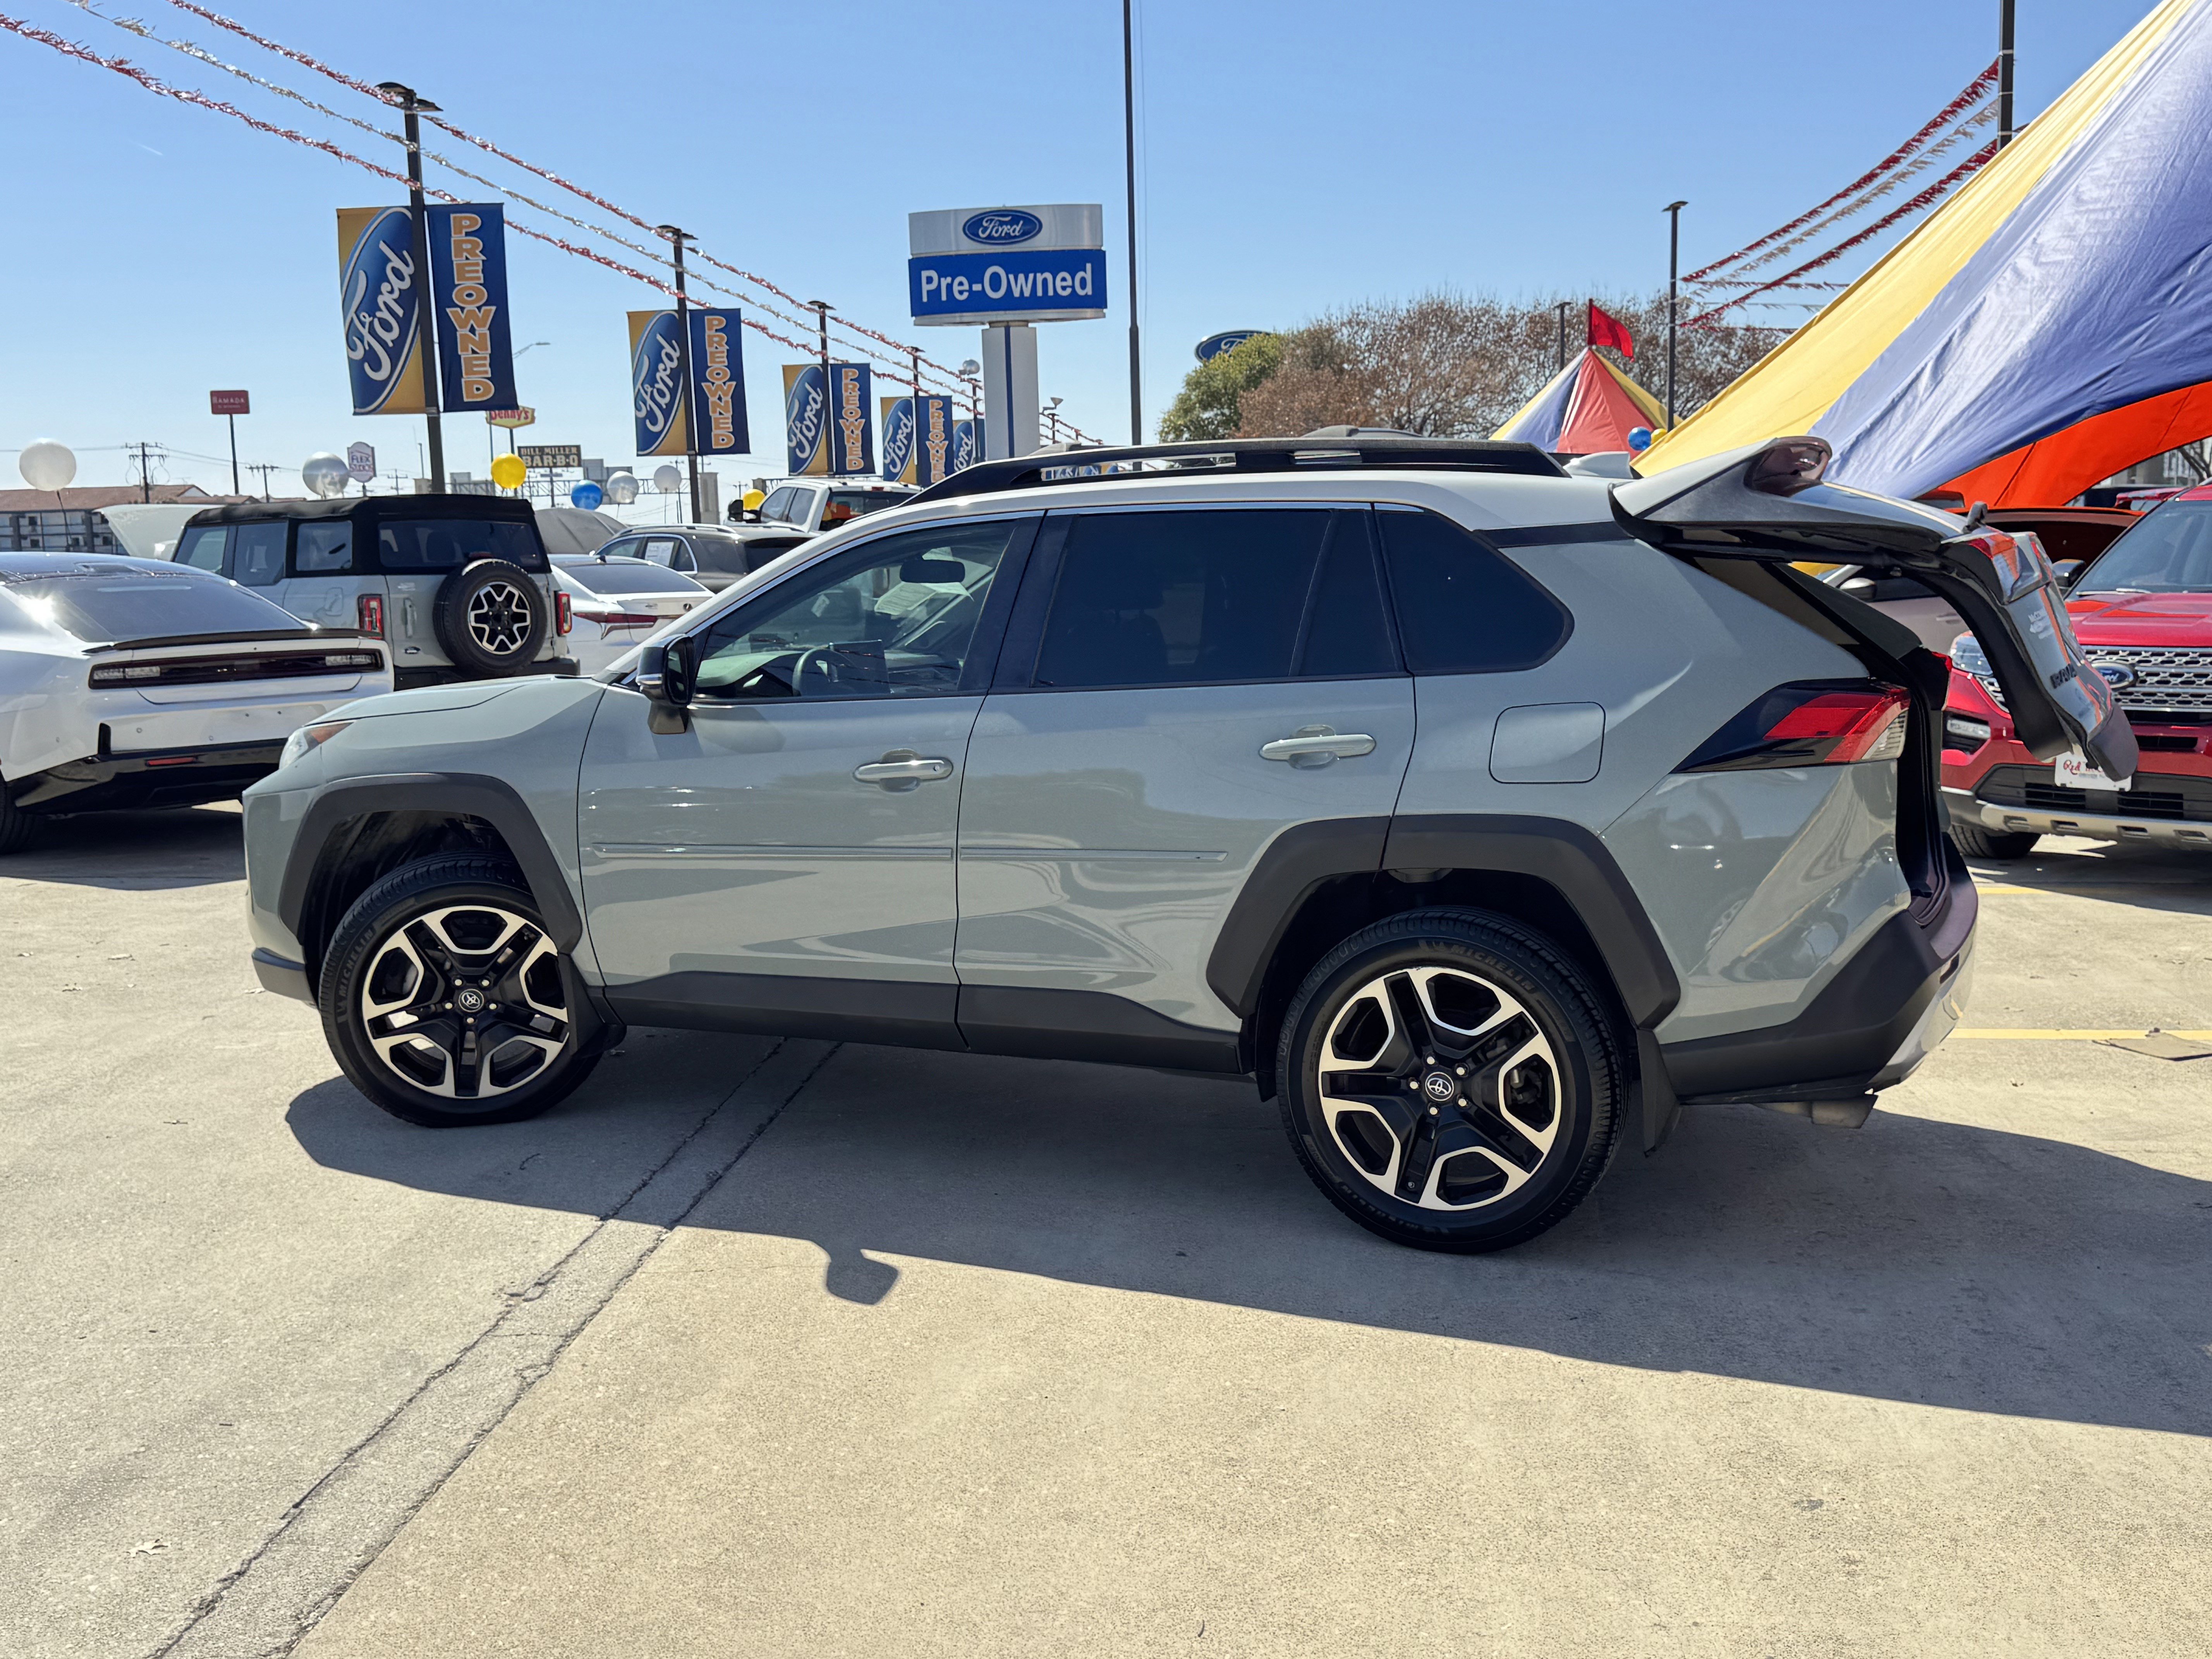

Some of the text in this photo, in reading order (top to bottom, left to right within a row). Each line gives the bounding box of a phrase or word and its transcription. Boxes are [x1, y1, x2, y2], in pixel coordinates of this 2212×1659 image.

[978, 215, 1024, 238] Ford
[346, 240, 415, 381] Ford
[446, 213, 497, 402] PREOWNED
[921, 263, 1092, 302] Pre-Owned
[634, 333, 680, 432] Ford
[701, 316, 737, 449] PREOWNED
[787, 382, 823, 459] Ford
[839, 368, 866, 470] PREOWNED
[883, 411, 913, 473] Ford
[954, 432, 972, 472] ord
[338, 929, 374, 997] MICHELIN
[1451, 944, 1536, 990] MICHELIN
